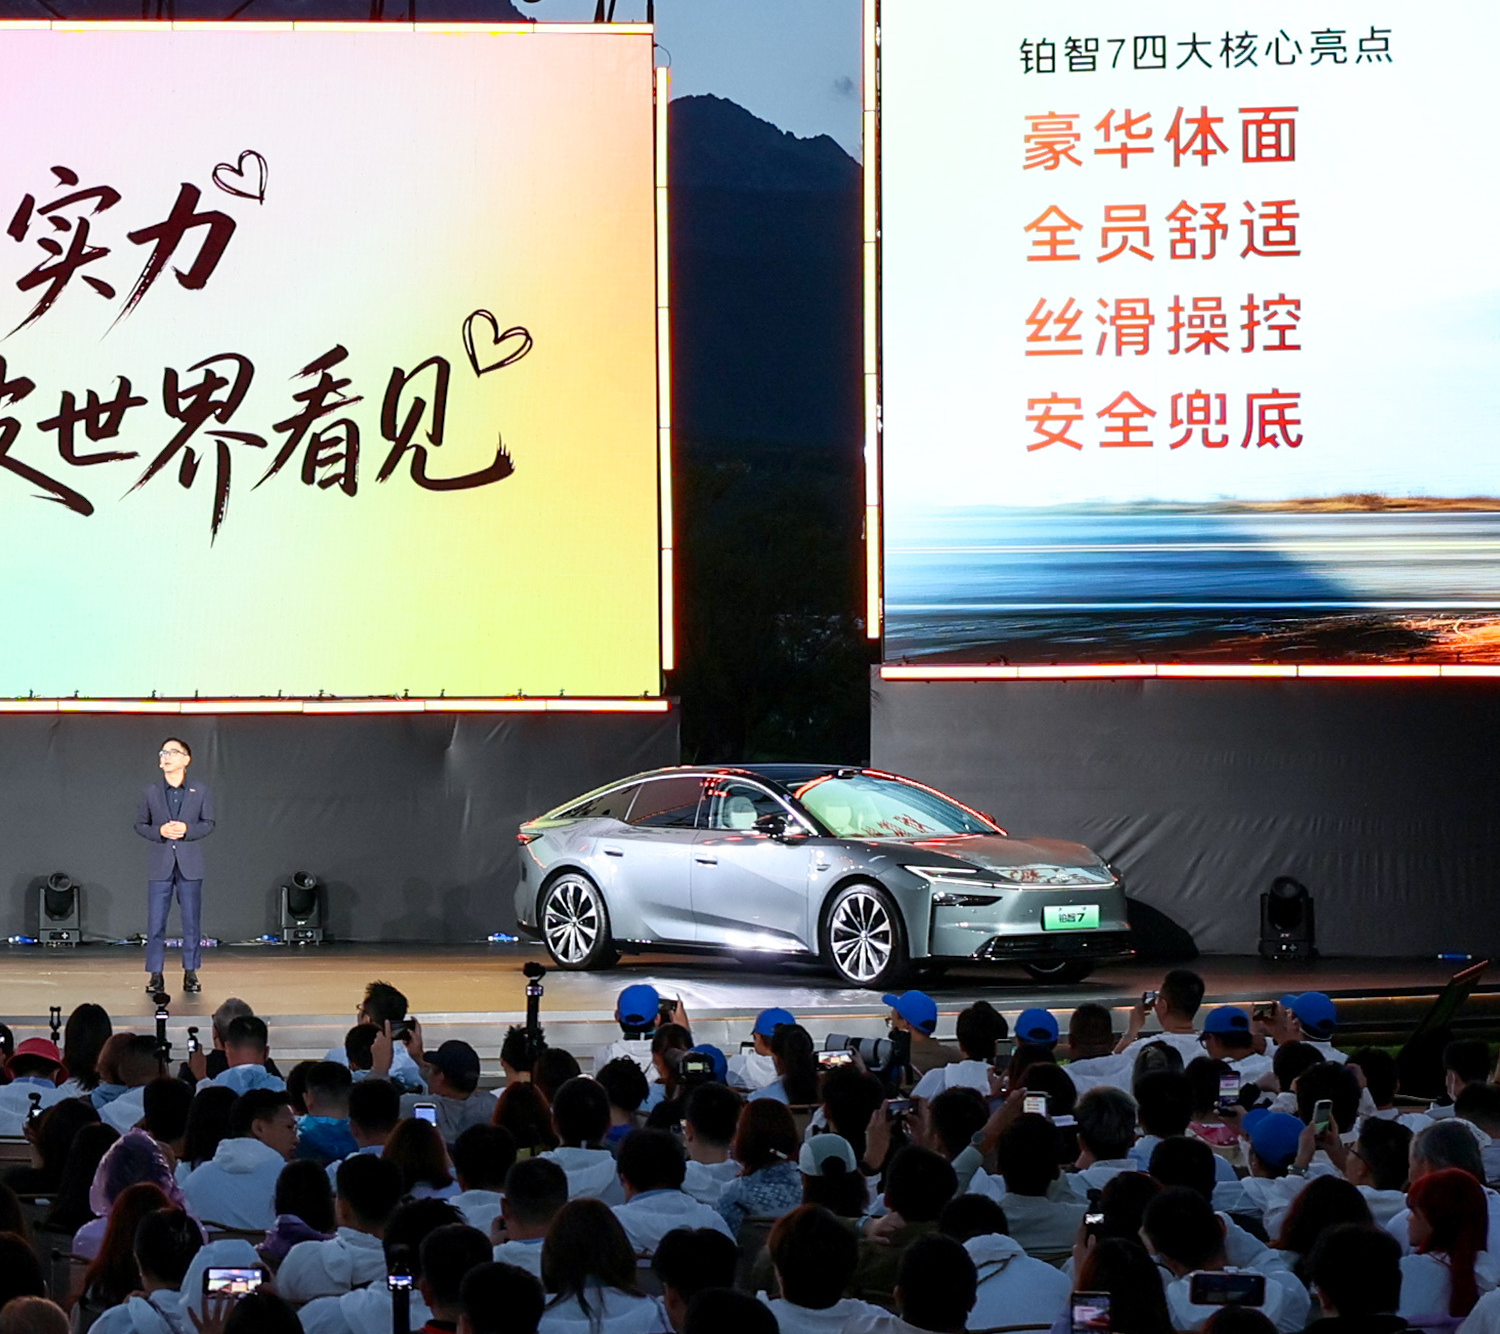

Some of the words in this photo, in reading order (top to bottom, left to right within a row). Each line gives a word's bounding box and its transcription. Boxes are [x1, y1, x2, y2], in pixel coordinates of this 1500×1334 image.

[1020, 25, 1393, 75] 铂智7四大核心亮点
[1022, 106, 1299, 170] 豪华体面
[1024, 199, 1302, 263] 全员舒适
[1024, 293, 1302, 357] 丝滑操控
[1025, 388, 1304, 452] 安全兜底
